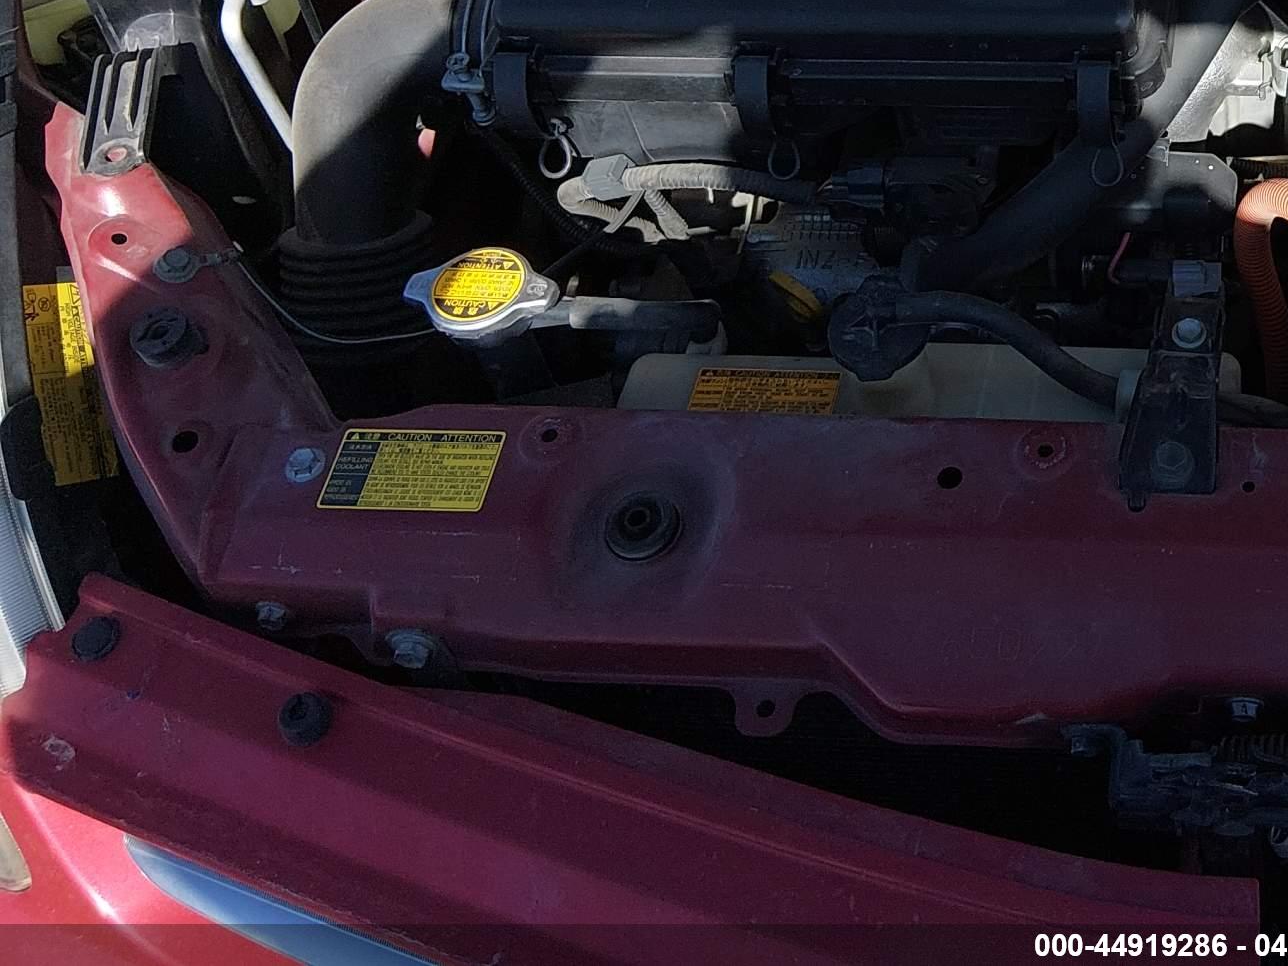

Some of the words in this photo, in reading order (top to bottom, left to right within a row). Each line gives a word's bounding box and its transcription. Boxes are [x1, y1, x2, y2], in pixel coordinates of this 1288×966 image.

[443, 300, 488, 309] CAUTION
[387, 433, 432, 442] CAUTION
[440, 434, 497, 442] ATTENTION
